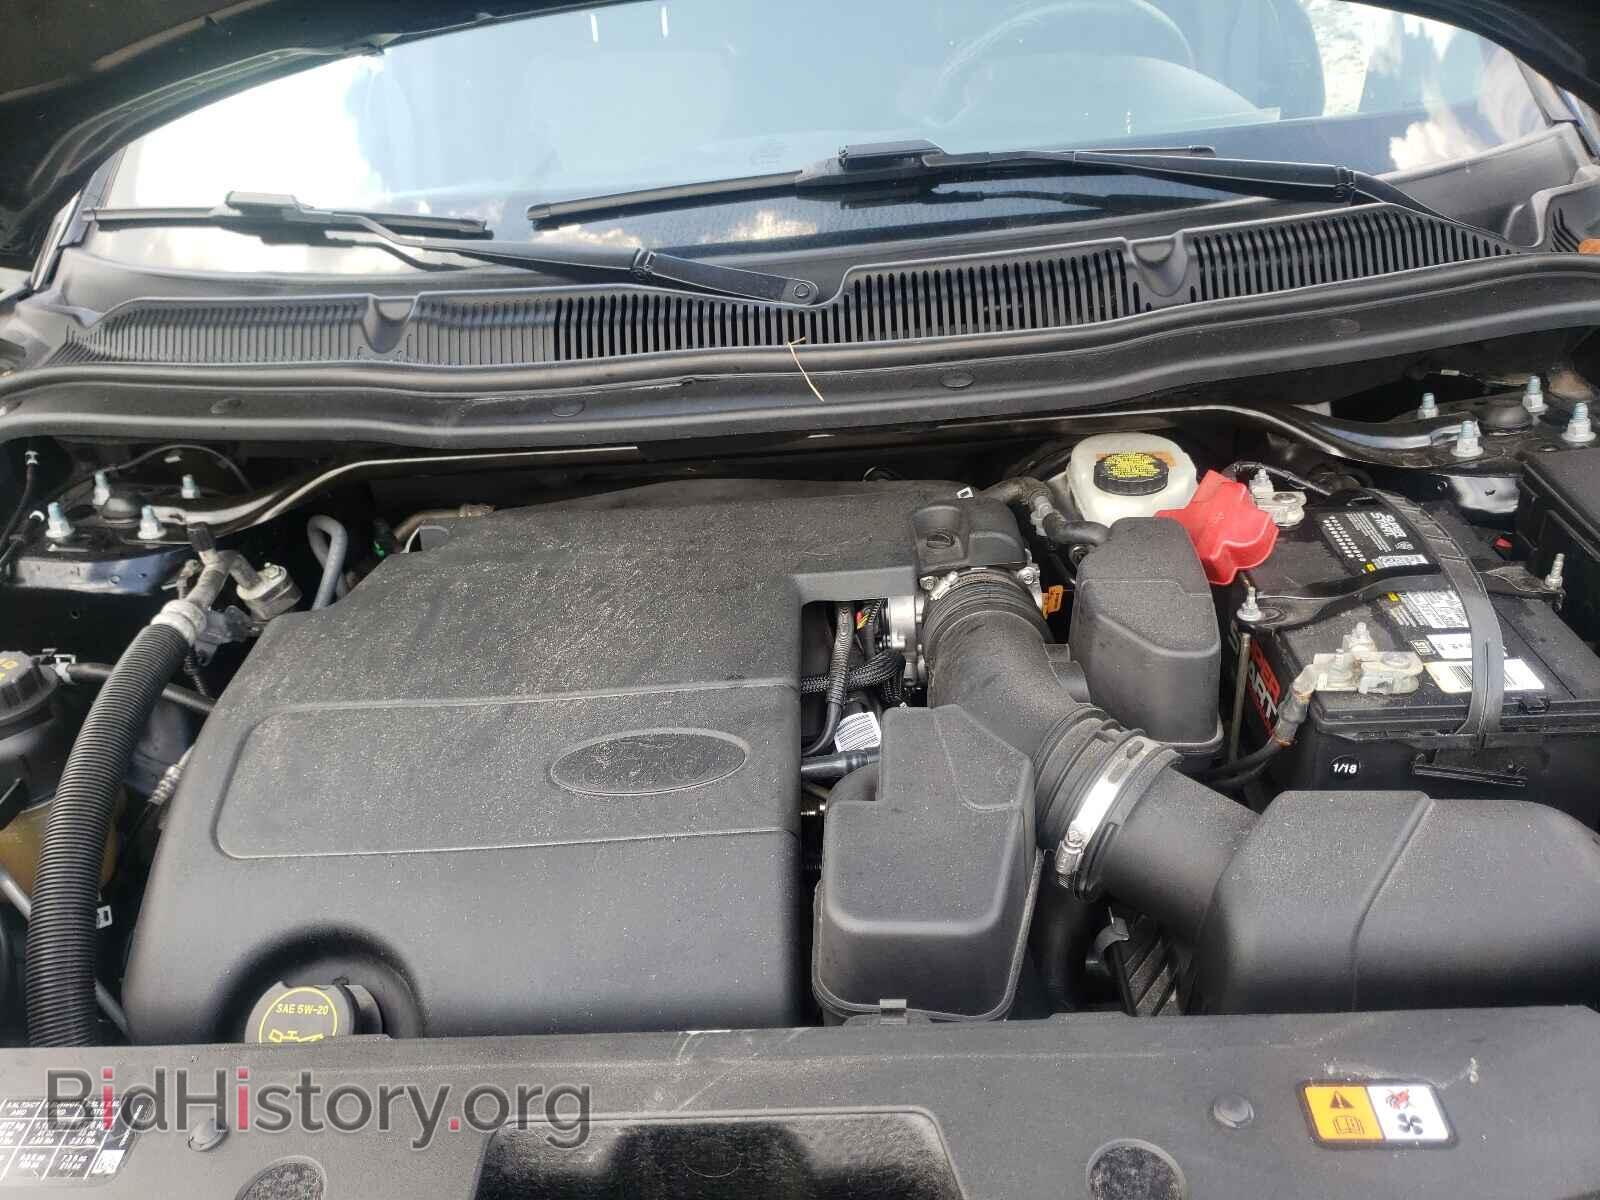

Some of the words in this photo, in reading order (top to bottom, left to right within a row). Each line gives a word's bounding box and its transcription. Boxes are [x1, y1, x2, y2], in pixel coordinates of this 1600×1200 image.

[1333, 763, 1357, 774] 1/18
[275, 1003, 296, 1014] SAE
[297, 1004, 329, 1016] 5W-20
